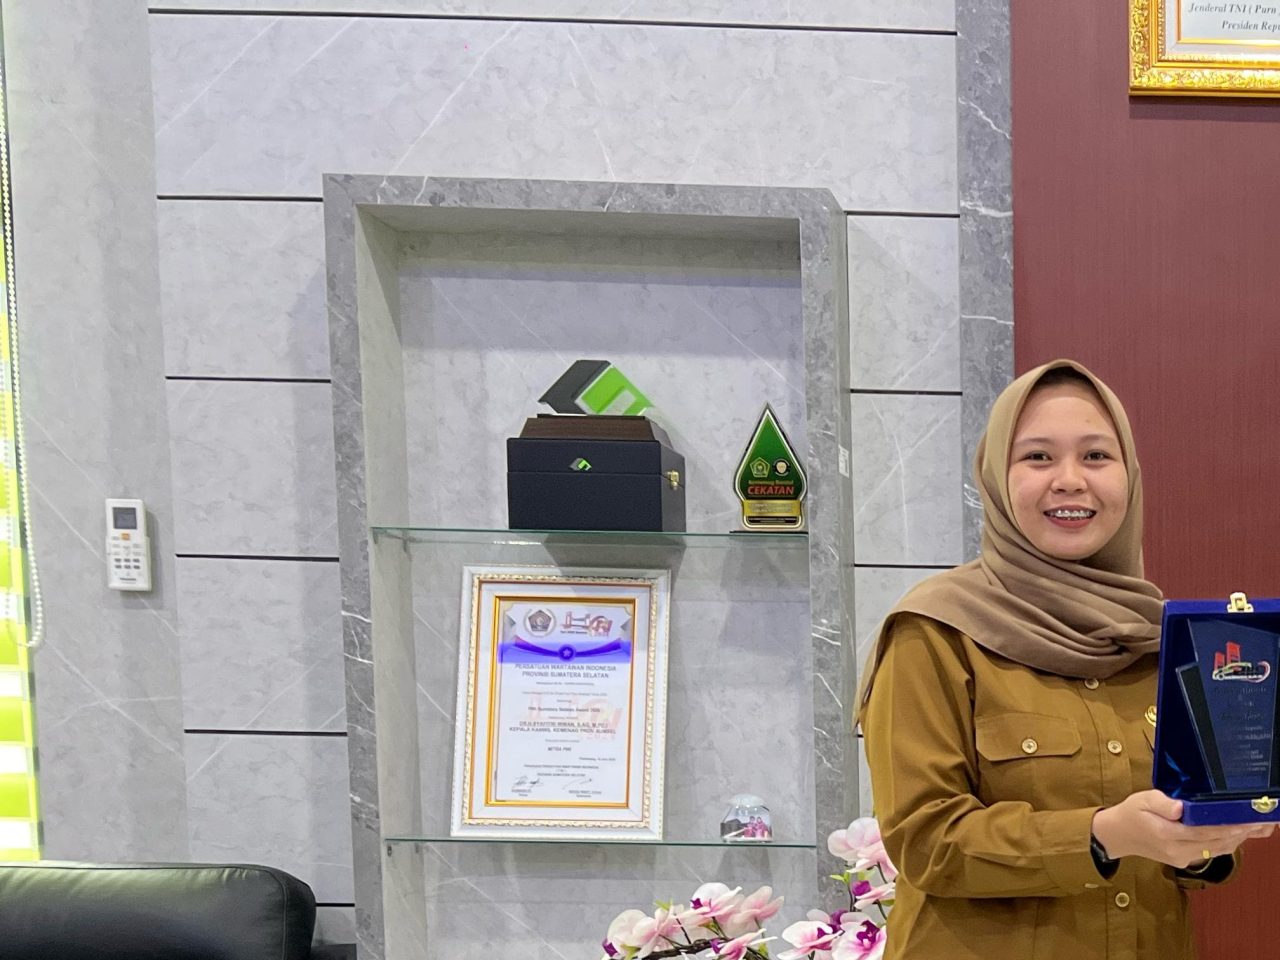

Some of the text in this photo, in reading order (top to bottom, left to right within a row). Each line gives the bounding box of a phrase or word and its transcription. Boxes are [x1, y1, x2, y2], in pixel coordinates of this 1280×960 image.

[1188, 3, 1226, 13] Jenderal
[1229, 4, 1246, 13] TNI
[1255, 4, 1276, 14] Purn
[1222, 20, 1259, 30] Presiden
[747, 485, 794, 495] CEKATAN
